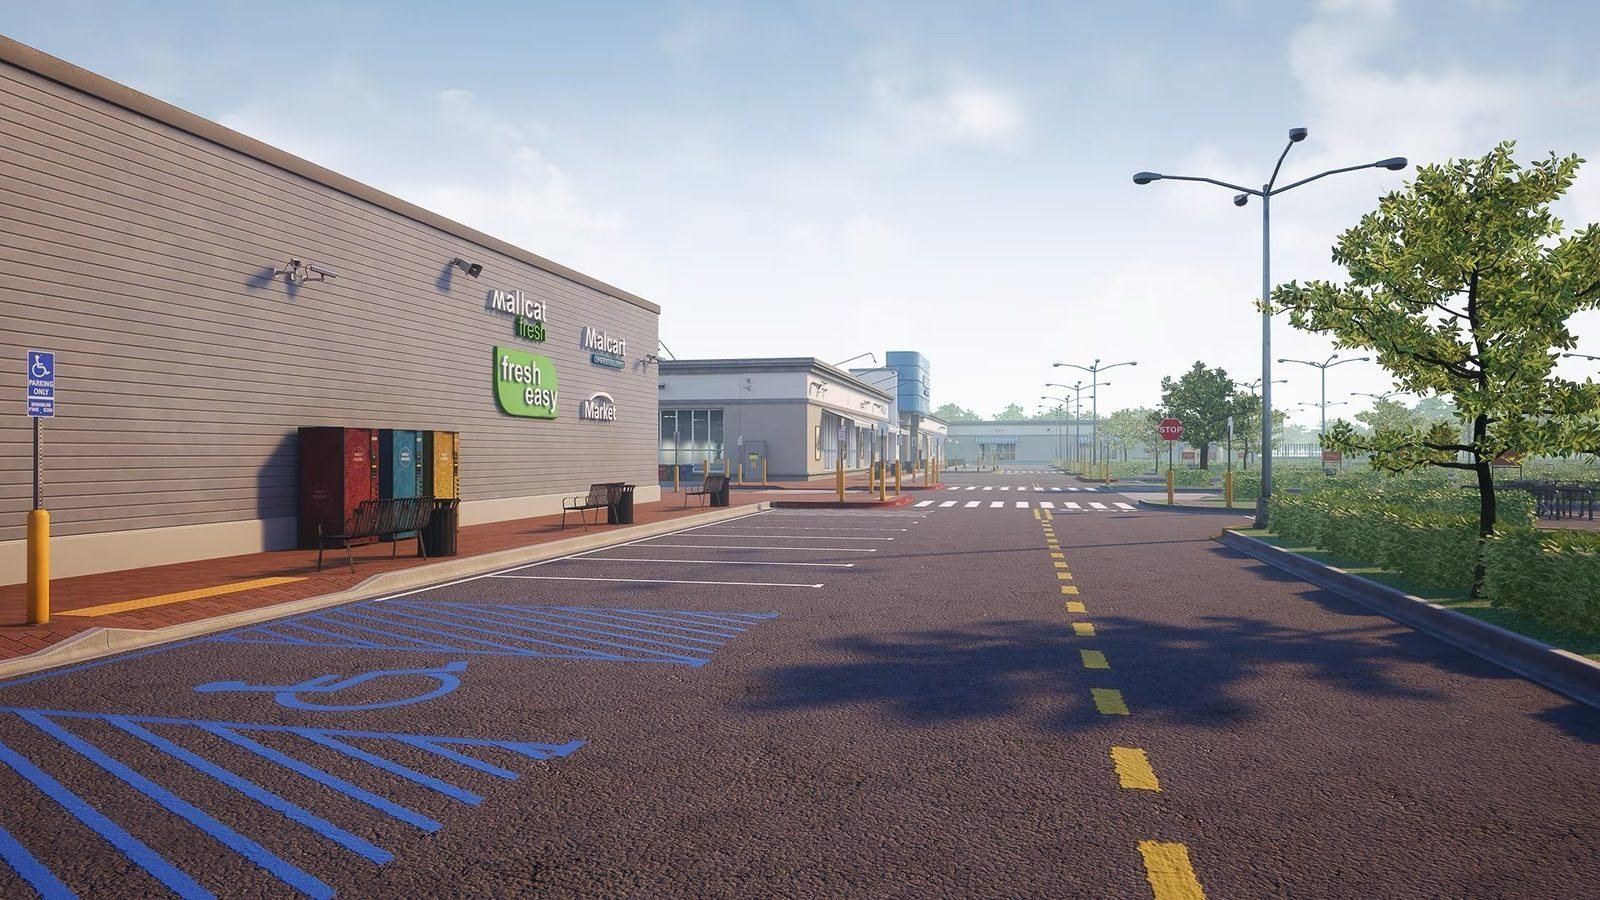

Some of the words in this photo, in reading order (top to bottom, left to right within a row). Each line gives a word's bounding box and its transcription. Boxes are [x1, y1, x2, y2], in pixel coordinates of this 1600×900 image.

[518, 317, 546, 341] fresh
[585, 326, 627, 357] Malcart
[502, 355, 541, 385] fresh
[526, 386, 558, 414] easy
[584, 400, 617, 421] Market
